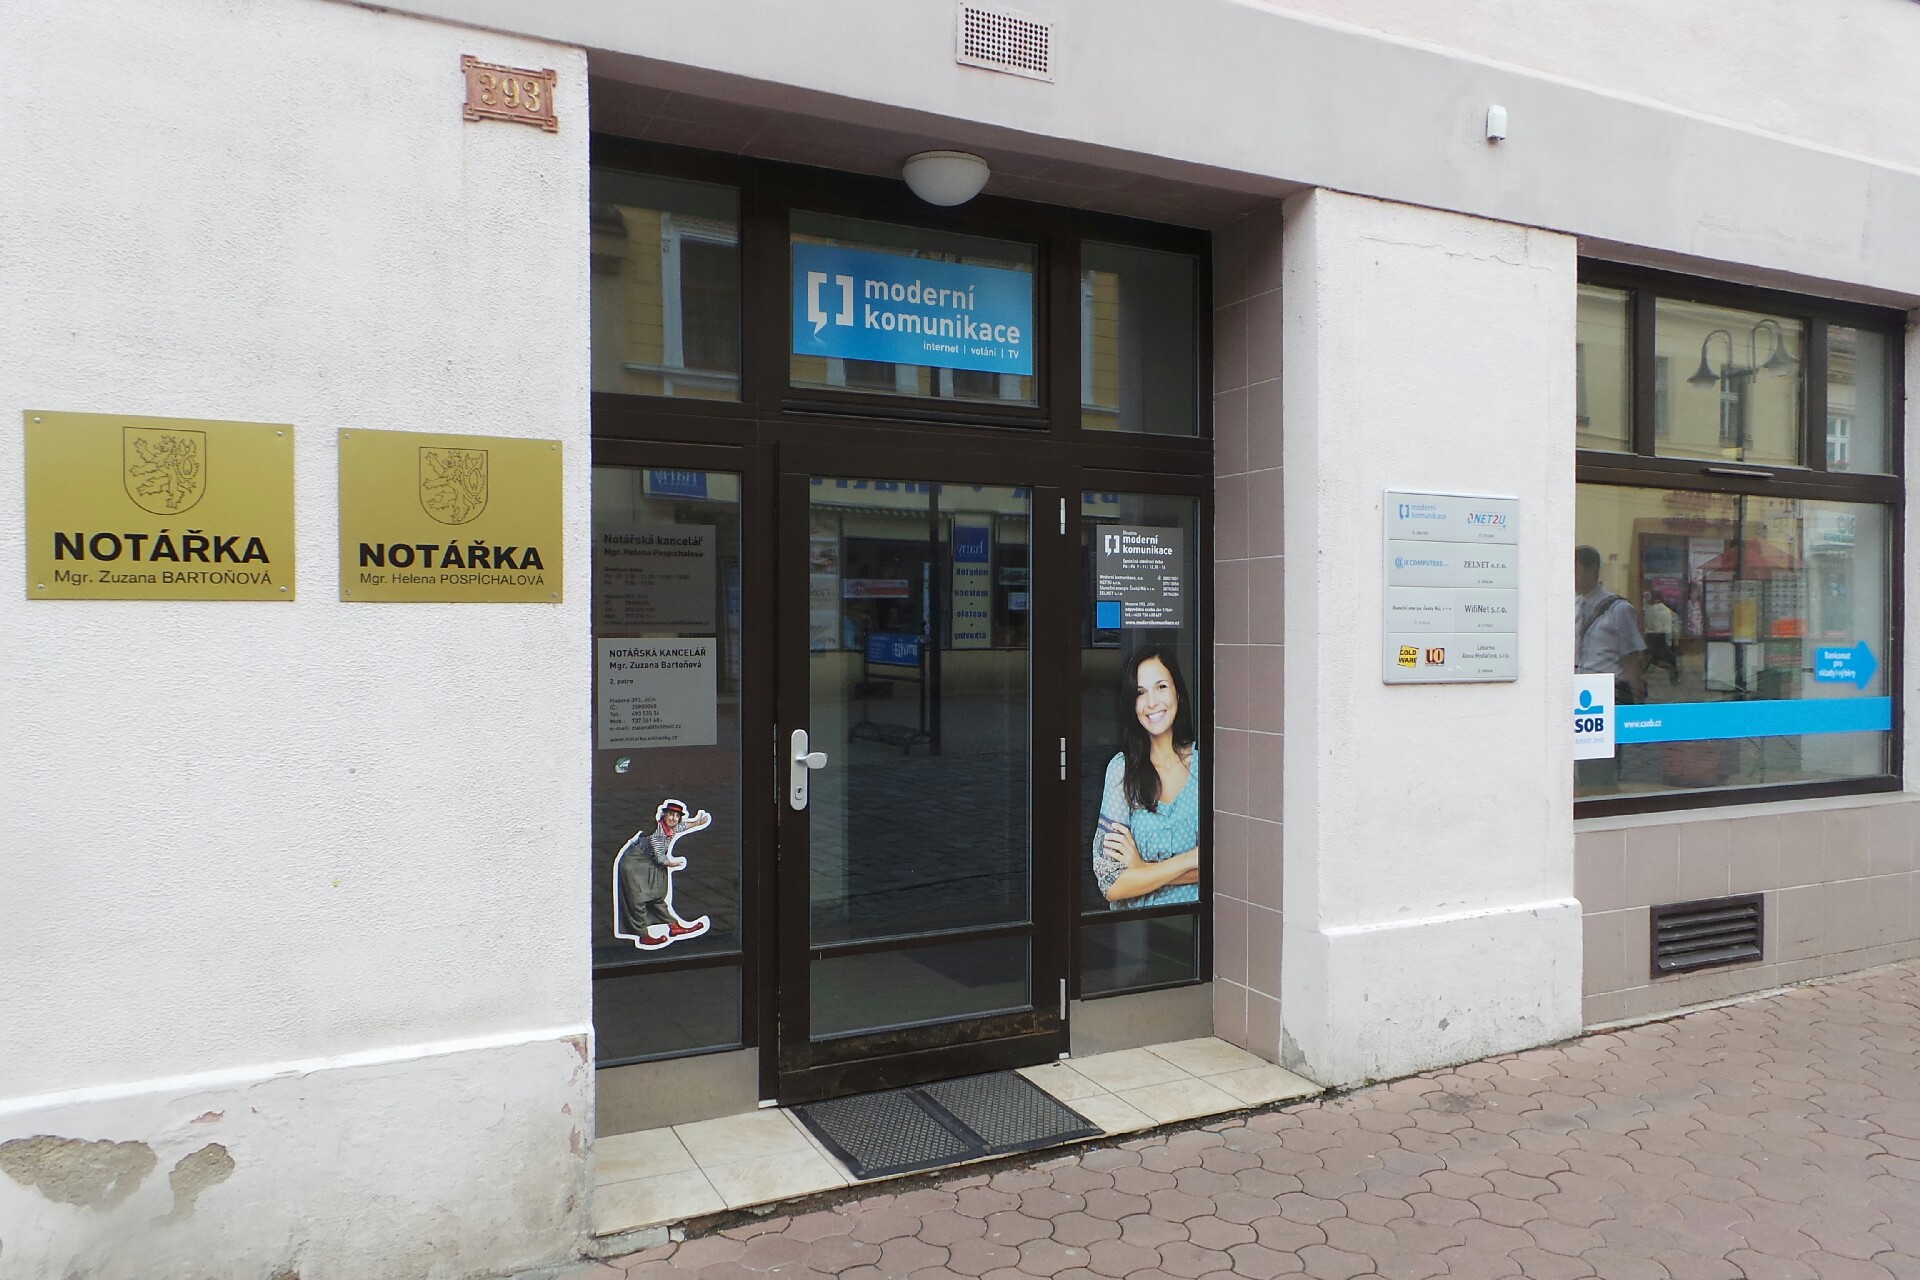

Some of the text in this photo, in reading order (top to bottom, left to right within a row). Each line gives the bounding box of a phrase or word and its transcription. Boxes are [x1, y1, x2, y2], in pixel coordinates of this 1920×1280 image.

[479, 74, 541, 112] 393
[864, 279, 975, 311] moderní
[864, 303, 1021, 344] komunikace
[923, 341, 1019, 359] internet volání TV
[54, 529, 270, 563] NOTÁŘKA
[604, 534, 703, 546] Notářská kancelář
[1122, 535, 1158, 545] moderní
[359, 540, 544, 570] NOTÁŘKA
[1122, 545, 1173, 556] komunikace
[1463, 561, 1489, 569] ZELNET
[54, 569, 272, 586] Mgr. Zuzana BARTOŇOVÁ
[360, 572, 544, 586] Mgr. Helena POSPÍCHALOVÁ
[1464, 604, 1490, 613] WifiNet
[609, 646, 706, 658] NOTÁŘSKÁ KANCELÁŘ
[609, 662, 628, 670] Mgr.
[661, 660, 702, 669] Bartoňová
